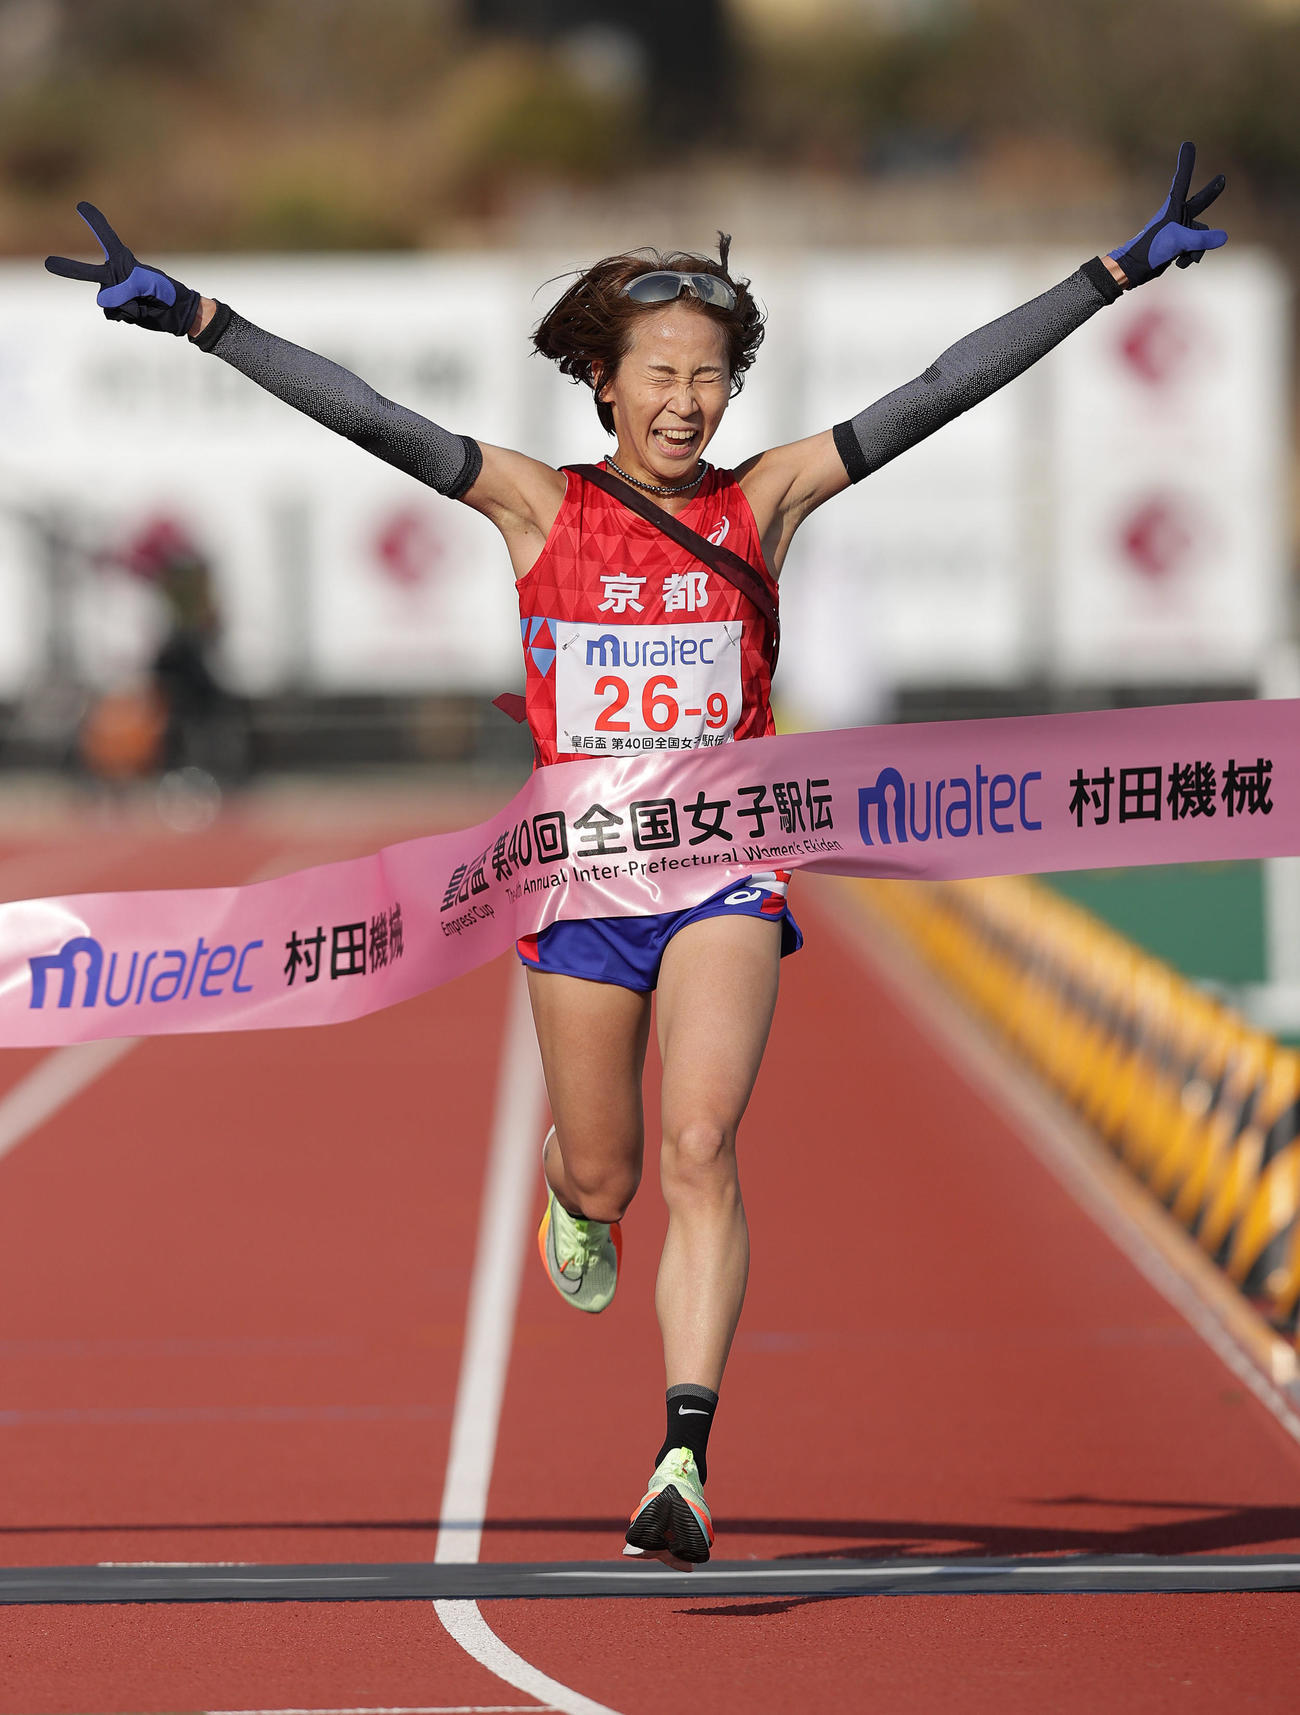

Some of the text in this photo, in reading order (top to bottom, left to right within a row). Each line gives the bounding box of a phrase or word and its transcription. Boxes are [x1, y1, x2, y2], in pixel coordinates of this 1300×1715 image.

[597, 571, 709, 613] 京都
[594, 675, 729, 733] 26-9
[571, 735, 607, 749] 皇后盃
[1069, 758, 1274, 828] 村田機械
[491, 778, 834, 882] 第40回全国女子駅伝
[523, 868, 568, 896] Annual
[573, 847, 739, 882] Inter-Prefectural
[743, 841, 805, 862] Women's
[804, 838, 845, 854] Ekiden
